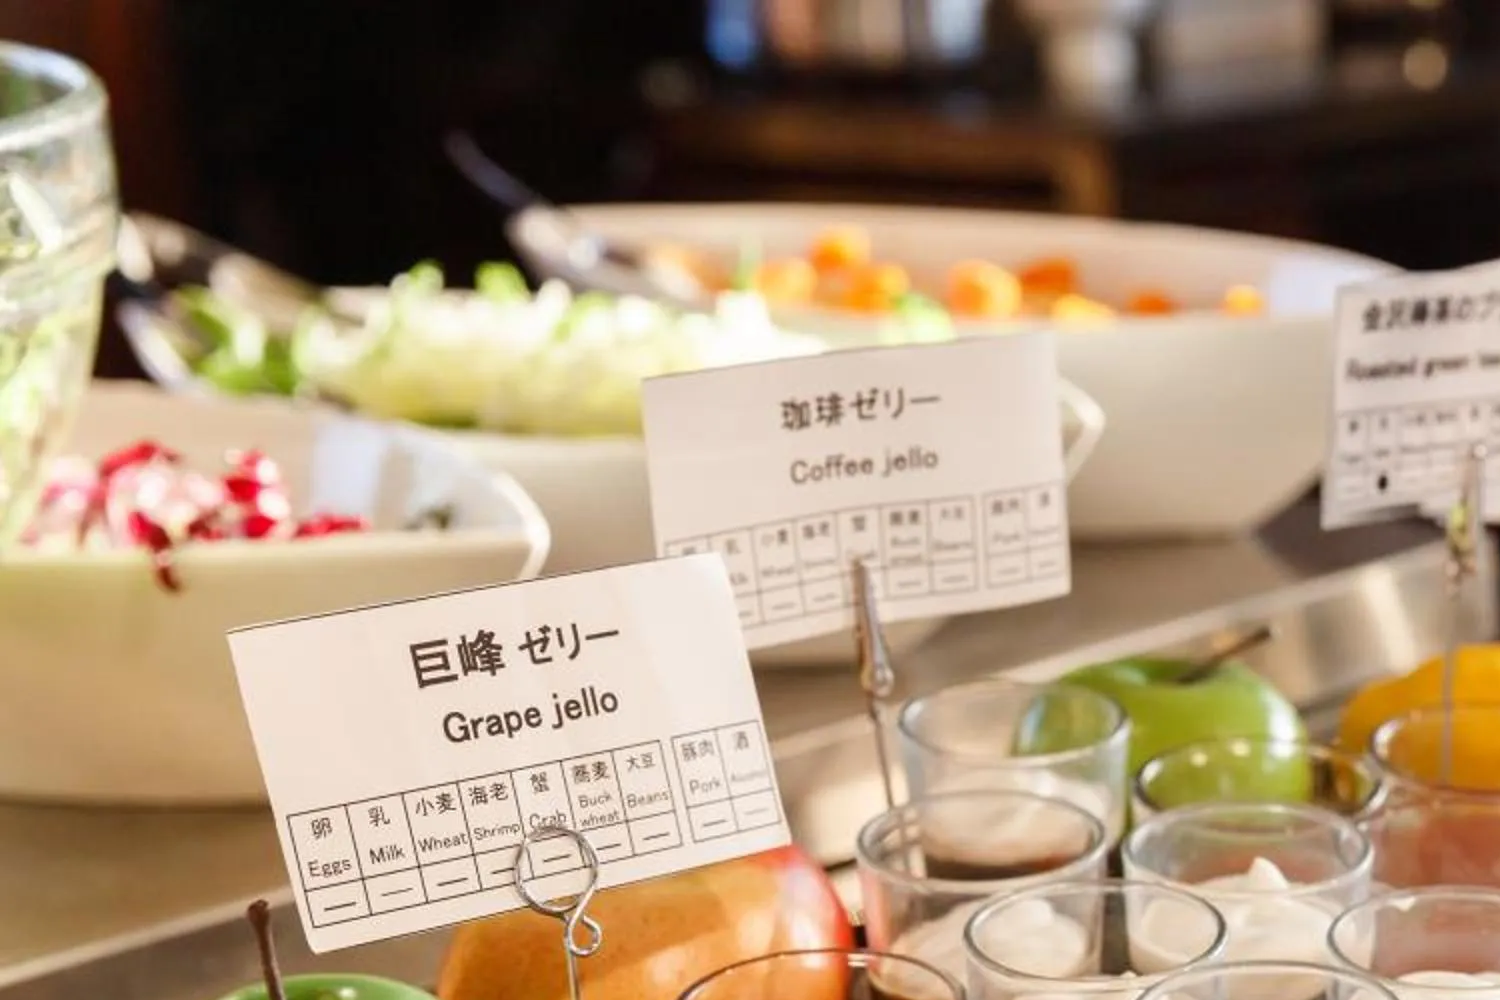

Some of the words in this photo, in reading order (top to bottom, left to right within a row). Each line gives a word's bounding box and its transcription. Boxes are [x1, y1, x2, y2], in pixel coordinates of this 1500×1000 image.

[780, 387, 942, 431] 珈琲ゼリー
[789, 453, 874, 485] Coffee
[882, 444, 939, 478] jello
[410, 629, 506, 689] 巨峰
[518, 623, 619, 665] ゼリー
[443, 706, 543, 743] Grape
[551, 686, 619, 730] jello
[311, 816, 333, 840] 卵
[368, 805, 390, 828] 乳
[415, 792, 457, 818] 小麦
[468, 782, 509, 807] 海老
[626, 752, 657, 772] 大豆
[578, 791, 612, 809] Buck
[580, 809, 621, 827] wheat
[308, 858, 352, 879] Eggs
[368, 844, 405, 866] Milk
[417, 832, 469, 852] Wheat
[473, 822, 520, 843] Shrimp
[529, 808, 568, 829] Crab
[626, 790, 670, 809] Beans
[689, 776, 721, 795] Pork
